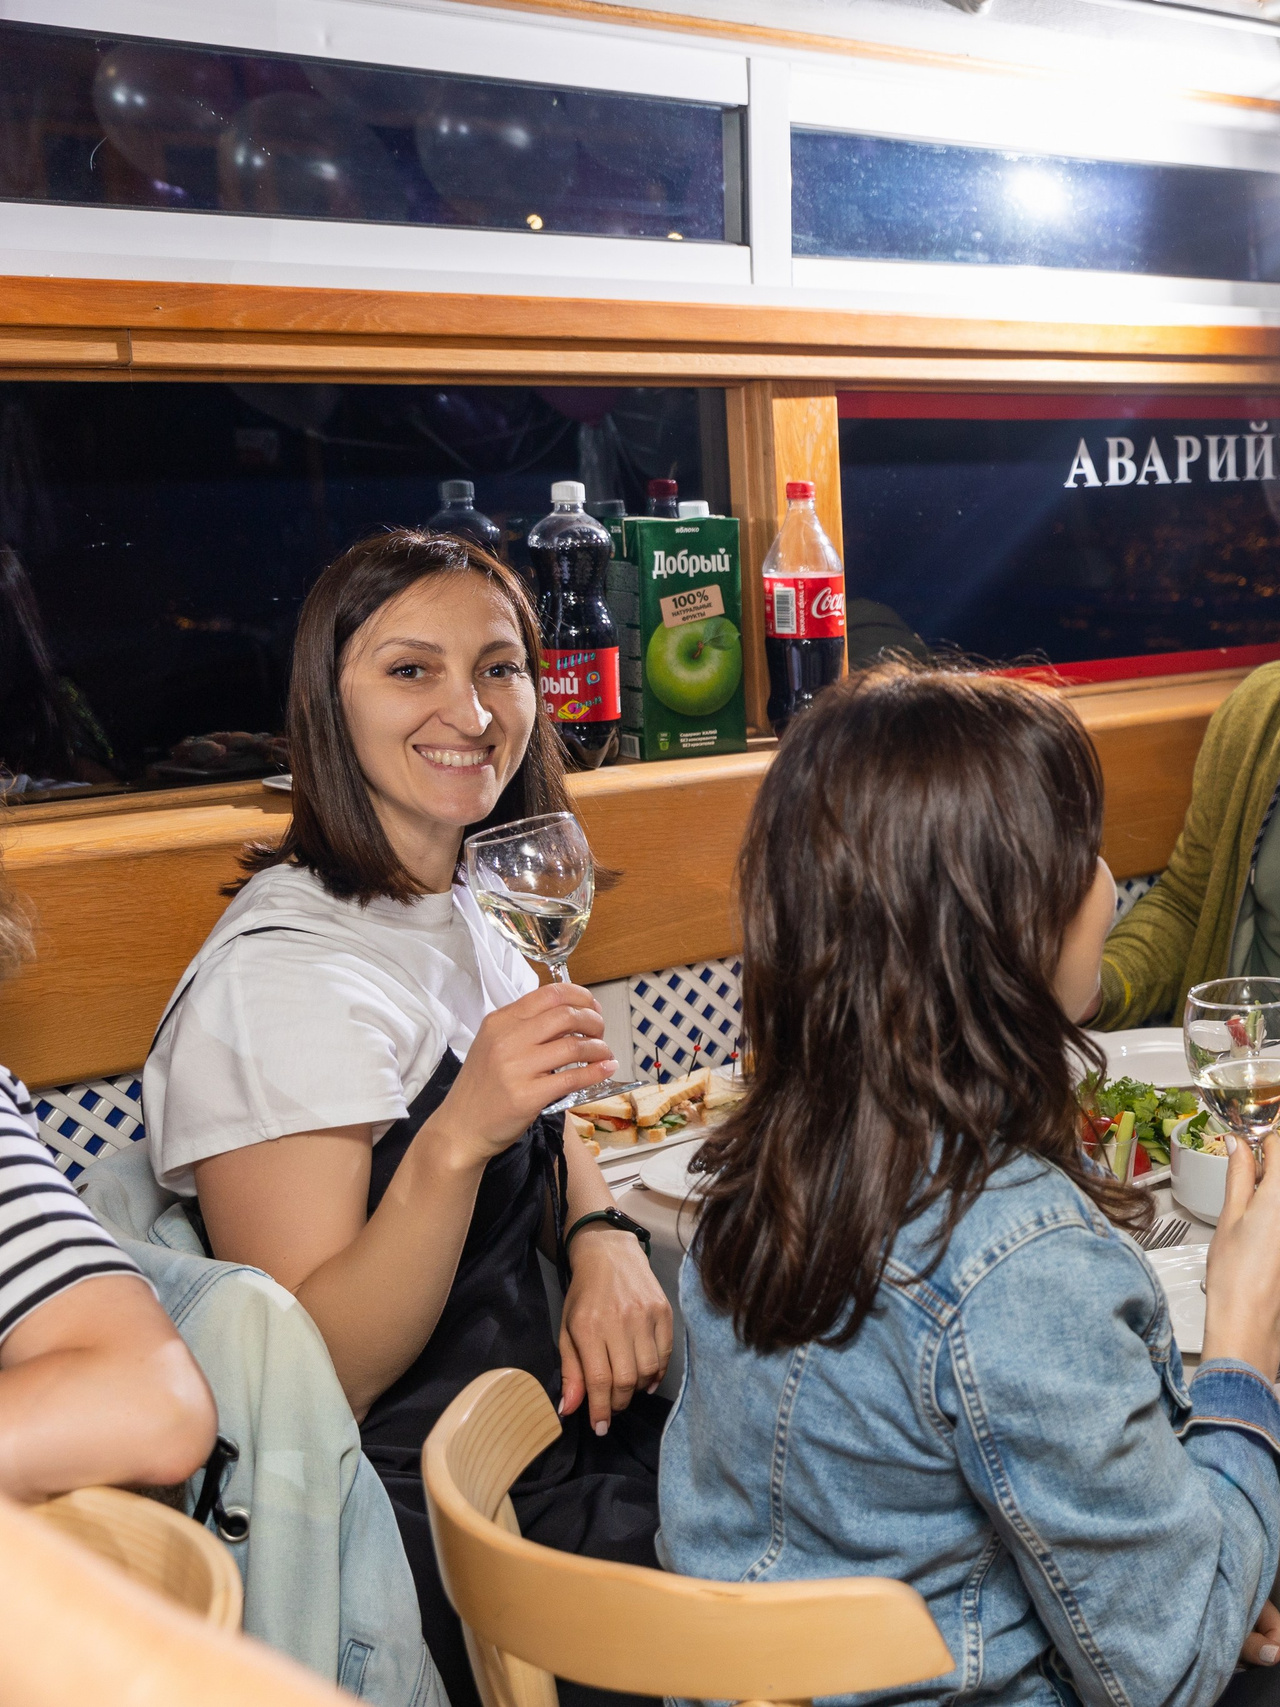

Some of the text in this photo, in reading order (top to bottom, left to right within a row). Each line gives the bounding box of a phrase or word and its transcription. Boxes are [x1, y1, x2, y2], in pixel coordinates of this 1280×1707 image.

[675, 526, 700, 534] яблоко
[652, 548, 731, 580] Добрый
[671, 590, 709, 609] 100%
[671, 602, 713, 617] НАТУРАЛЬНЫЕ
[682, 612, 706, 622] ФРУКТЫ
[540, 671, 579, 696] рый
